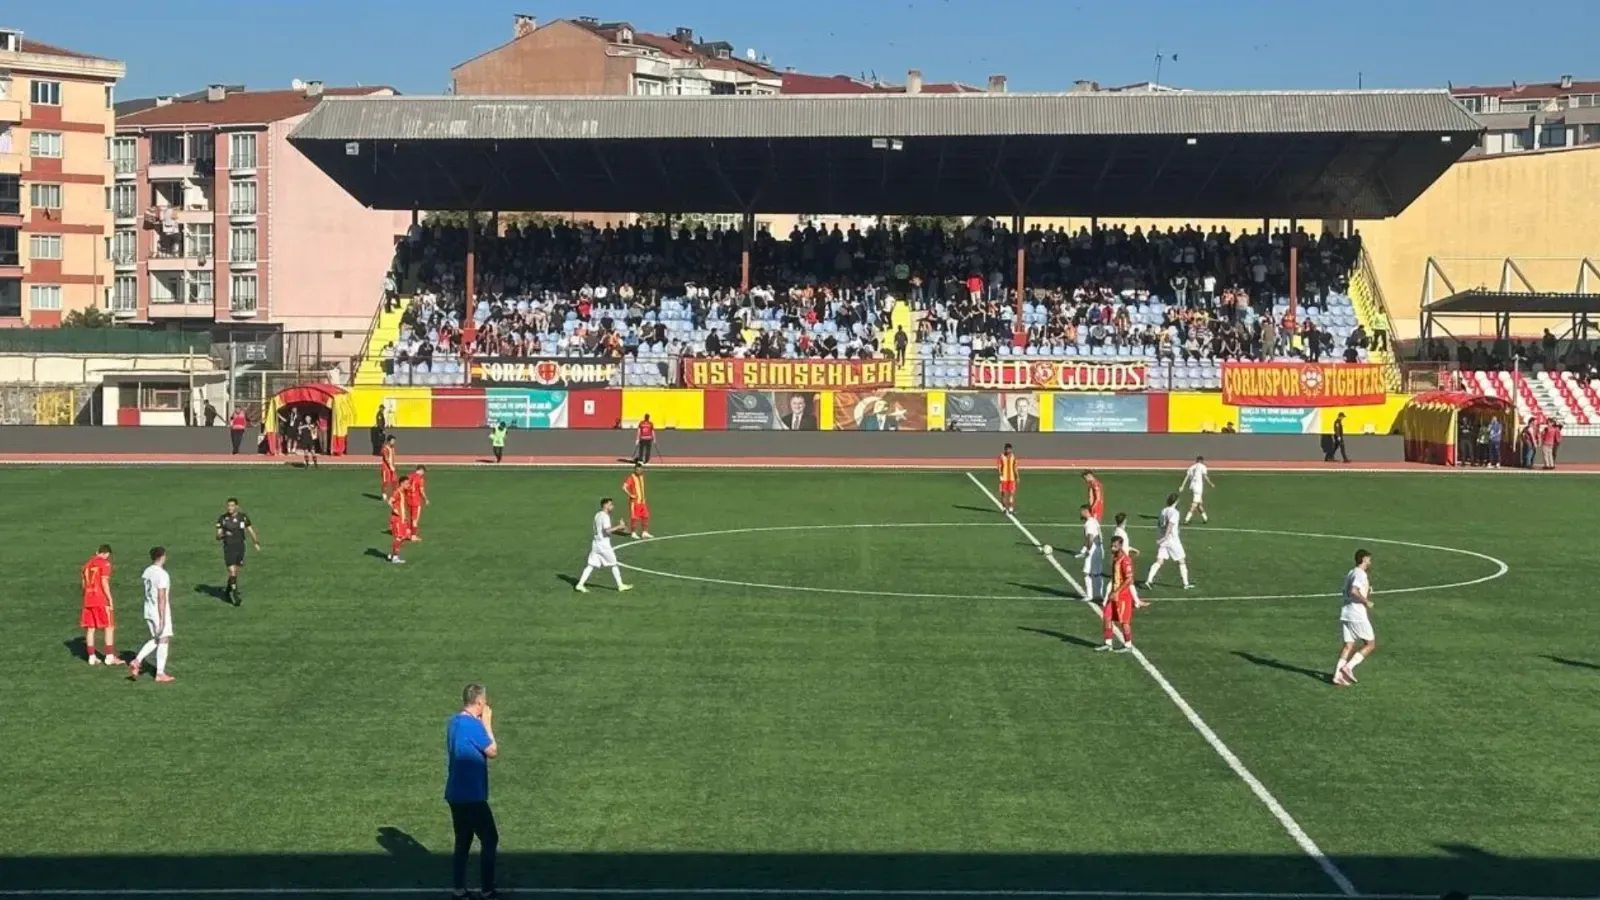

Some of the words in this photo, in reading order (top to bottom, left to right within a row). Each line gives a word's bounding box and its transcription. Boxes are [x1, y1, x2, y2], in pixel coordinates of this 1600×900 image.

[480, 362, 537, 382] FORZA
[976, 360, 1031, 389] OLD
[1058, 360, 1147, 390] GOODS
[1224, 367, 1300, 403] ÇORLUSPOR
[84, 567, 99, 585] 17
